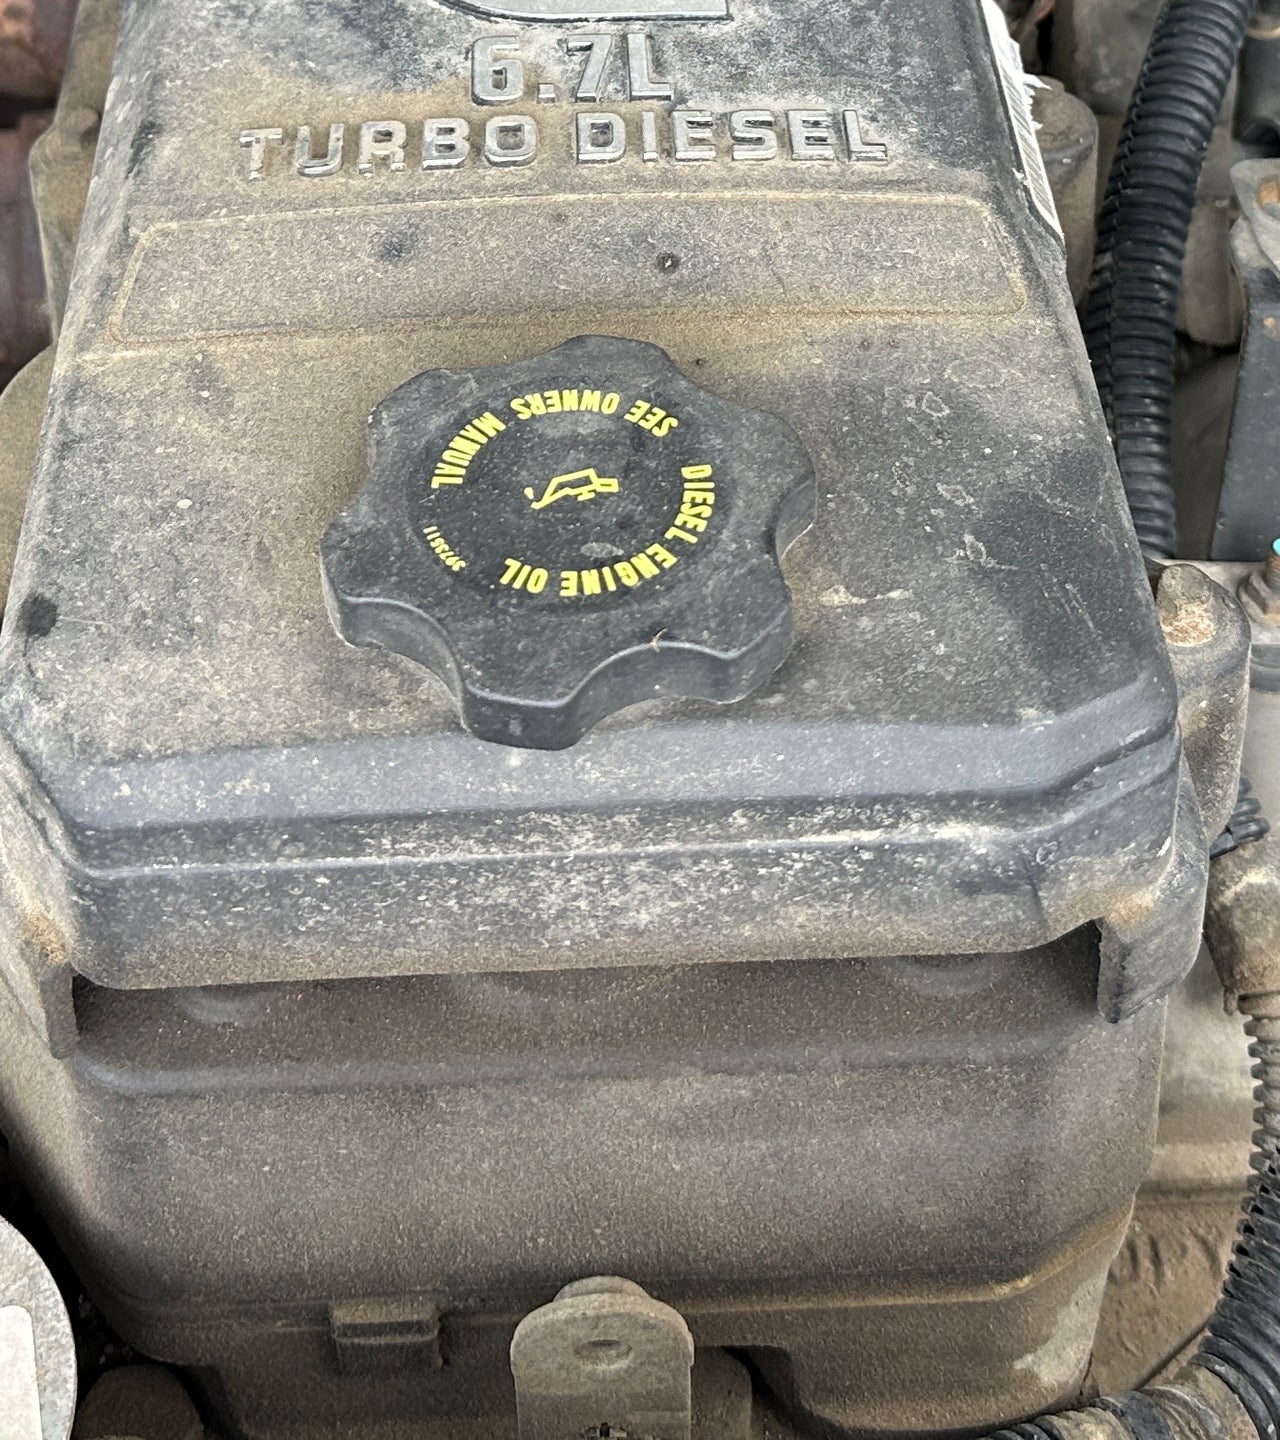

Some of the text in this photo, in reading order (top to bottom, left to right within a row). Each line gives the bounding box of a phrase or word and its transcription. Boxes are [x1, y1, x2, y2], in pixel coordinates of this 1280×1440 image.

[470, 32, 675, 105] 6.7L
[239, 109, 889, 180] TURBO DIESEL
[431, 388, 679, 489] SEE OWNERS MANUAL
[499, 464, 715, 598] DIESEL ENGINE OIL
